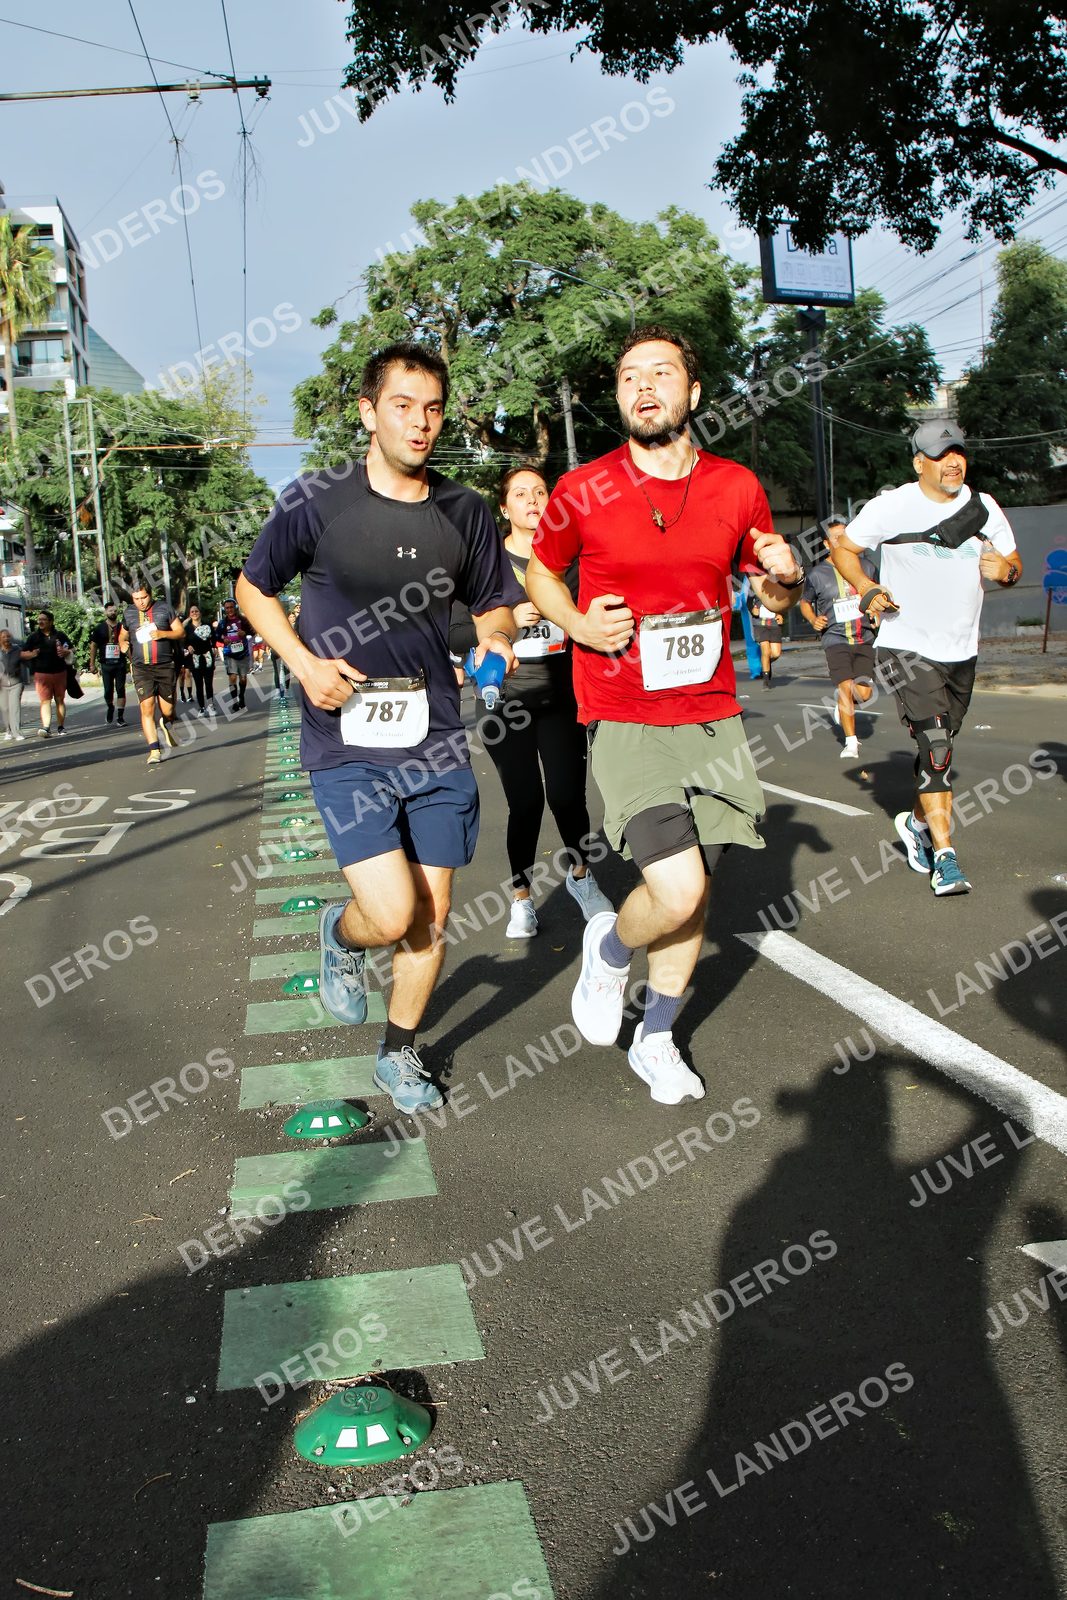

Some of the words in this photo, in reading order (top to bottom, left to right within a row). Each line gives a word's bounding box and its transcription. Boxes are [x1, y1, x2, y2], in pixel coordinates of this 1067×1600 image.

[522, 625, 551, 640] 230
[663, 634, 704, 661] 788
[365, 700, 408, 723] 787
